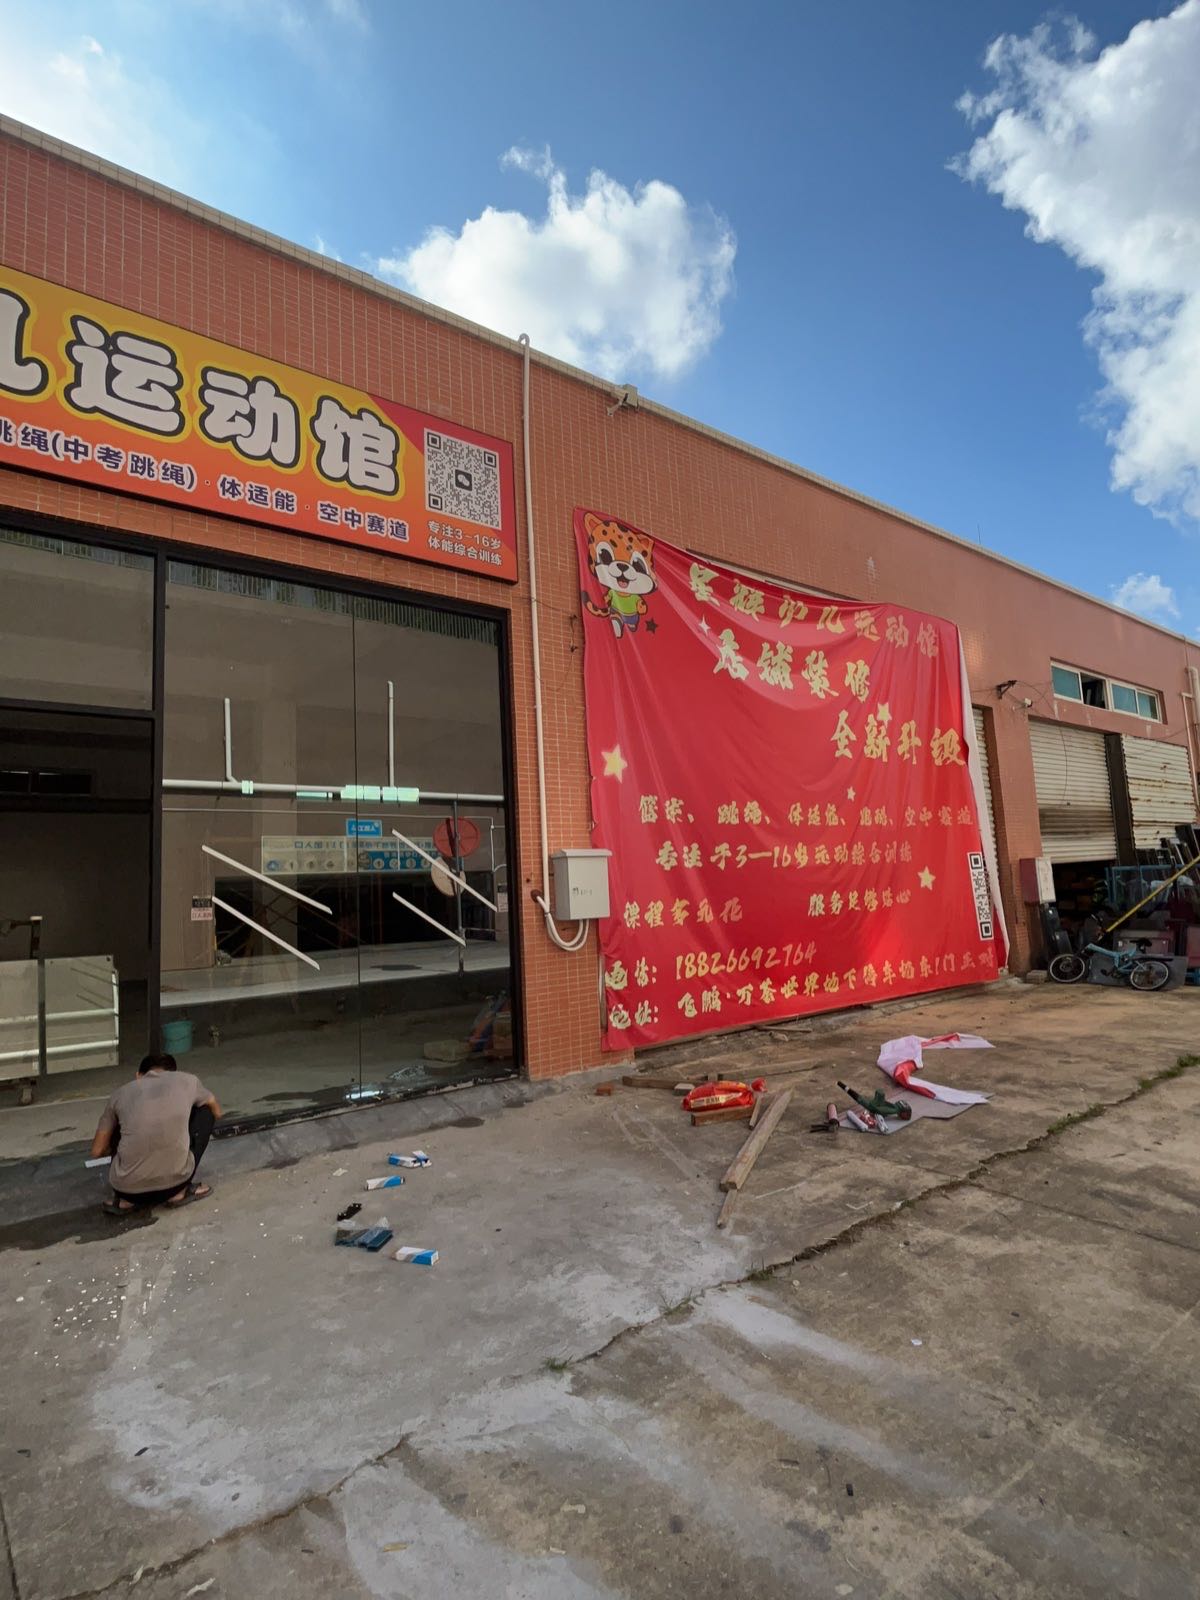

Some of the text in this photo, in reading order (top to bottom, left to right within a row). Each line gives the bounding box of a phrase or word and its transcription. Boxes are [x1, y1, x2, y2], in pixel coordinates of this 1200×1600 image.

[428, 535, 503, 566] 体能综合训练
[712, 628, 870, 704] 店铺装修
[830, 709, 966, 767] 全新升级
[623, 888, 912, 929] 课程多元化 服务足够贴心
[675, 940, 817, 981] 18826692764
